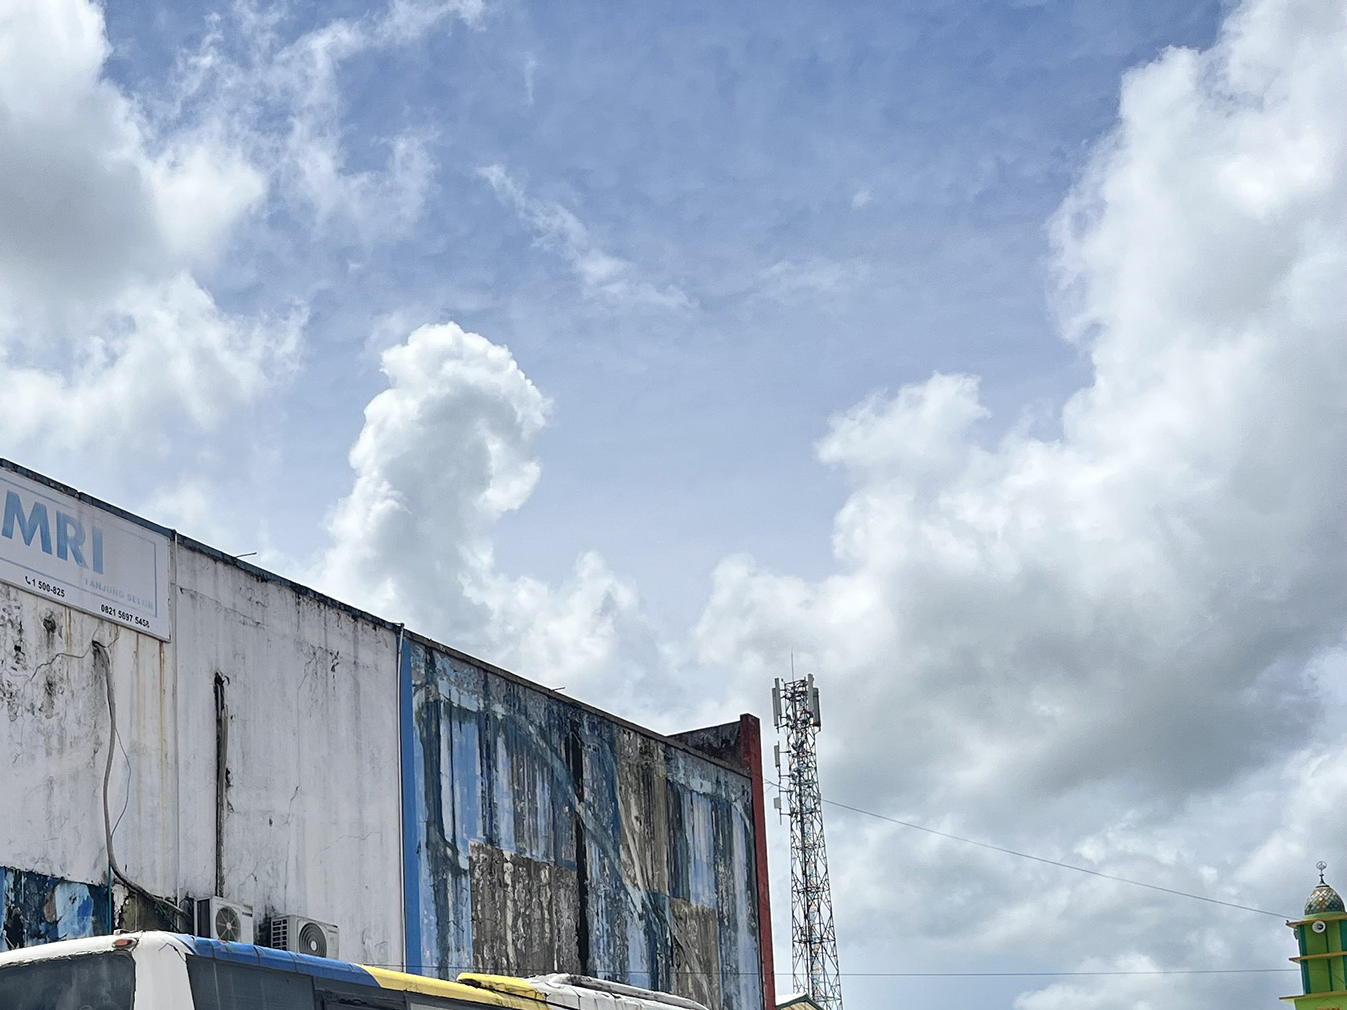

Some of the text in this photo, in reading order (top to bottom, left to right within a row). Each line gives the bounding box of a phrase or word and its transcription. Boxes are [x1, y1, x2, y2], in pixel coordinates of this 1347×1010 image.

[38, 580, 66, 598] 500-825
[100, 603, 117, 617] 0821
[118, 609, 133, 623] 5697
